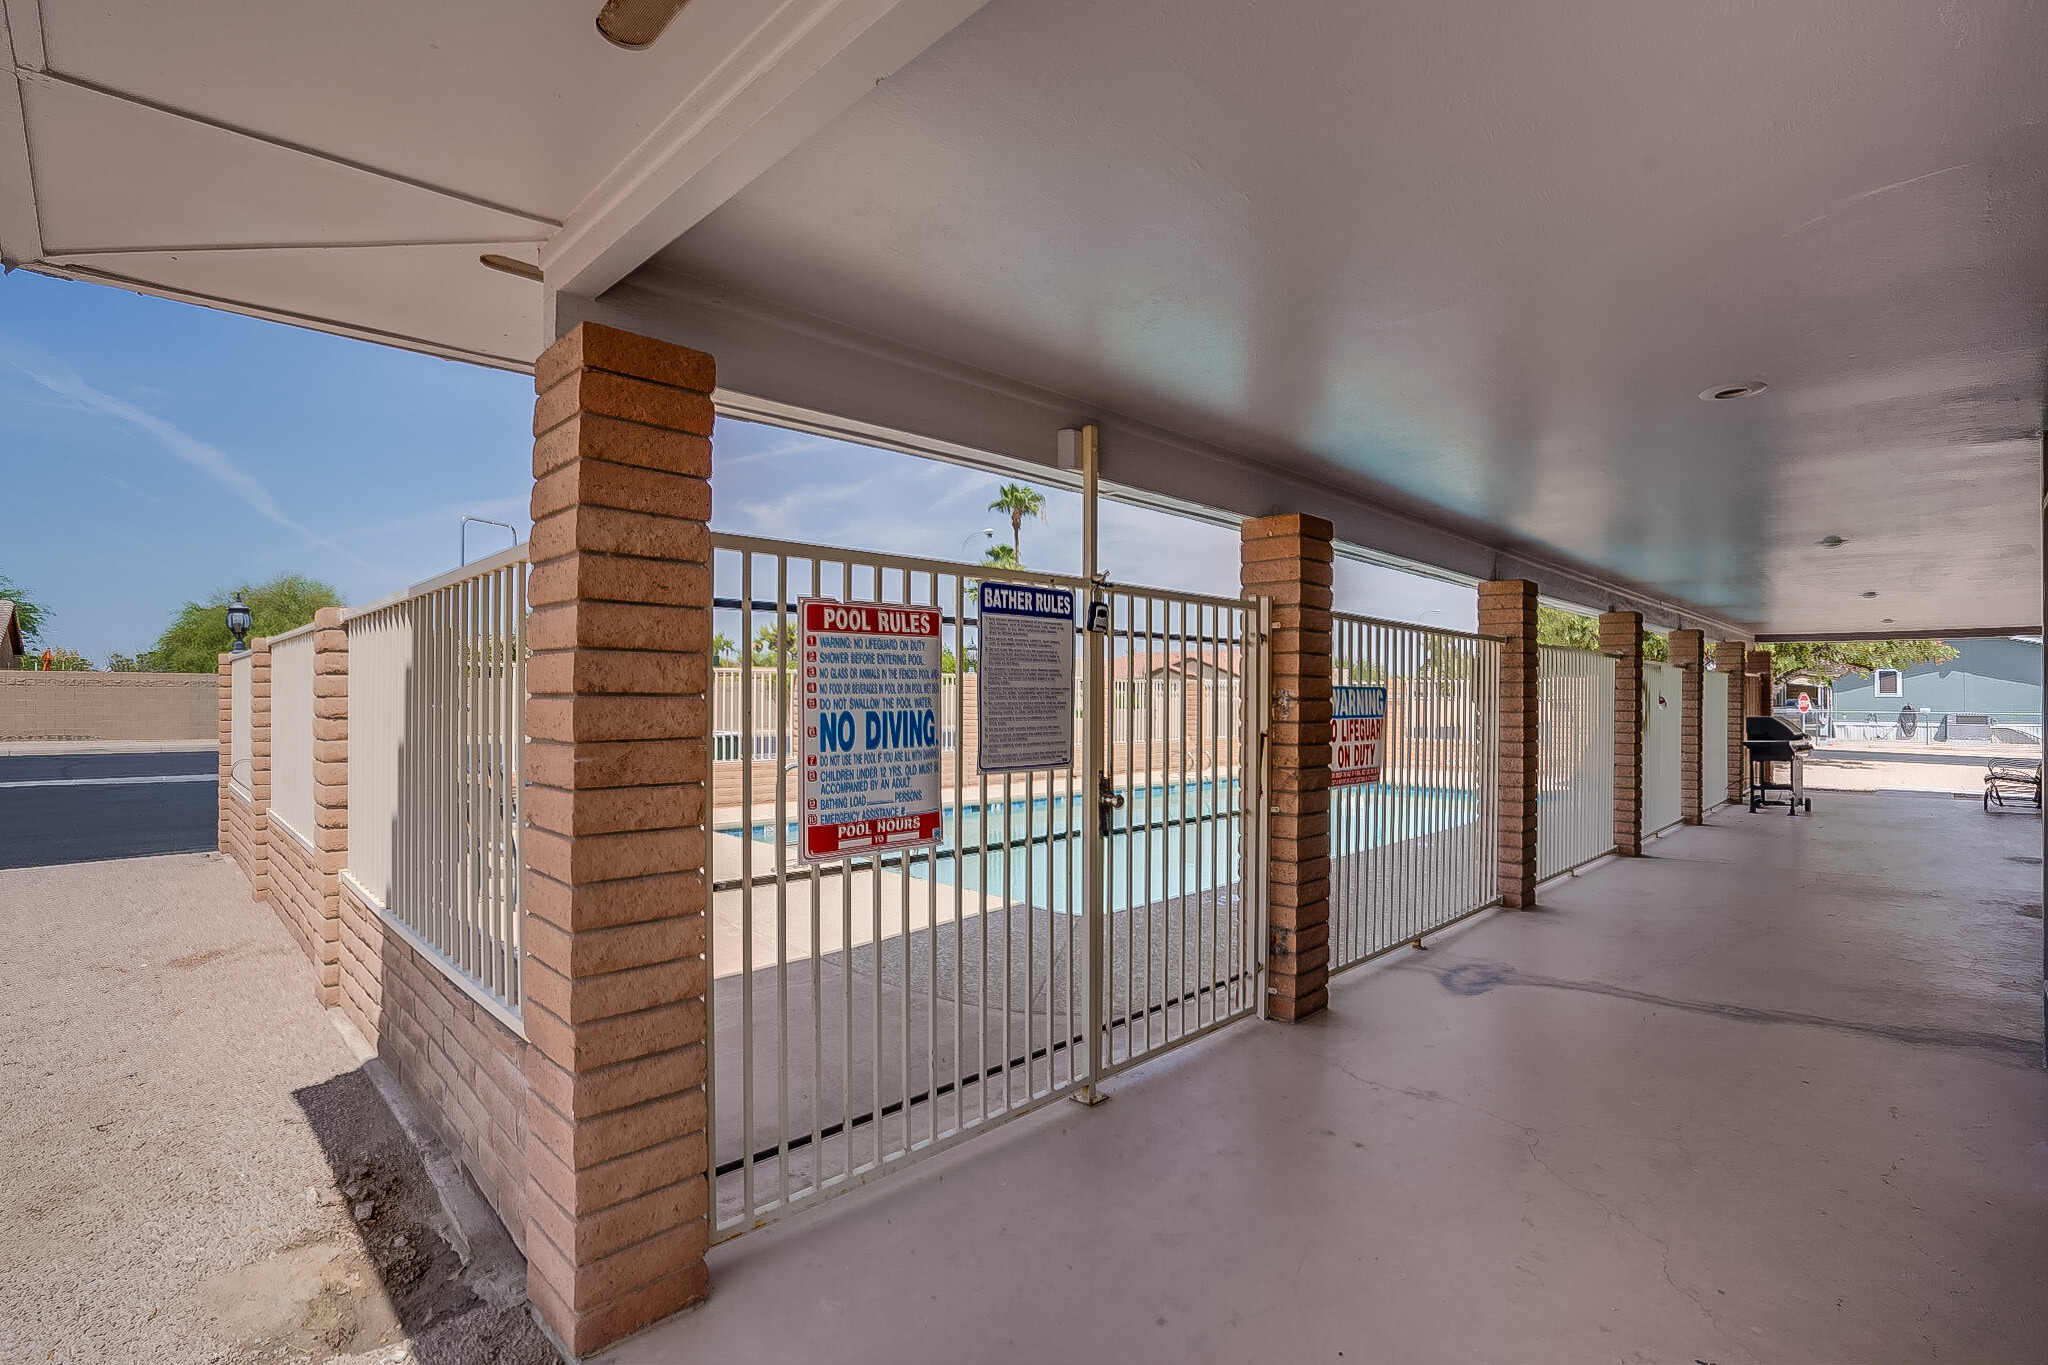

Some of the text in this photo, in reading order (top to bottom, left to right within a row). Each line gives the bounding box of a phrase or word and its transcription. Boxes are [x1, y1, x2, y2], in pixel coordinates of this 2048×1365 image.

[984, 587, 1071, 614] BATHER RULES
[823, 607, 931, 634] POOL RULES
[854, 637, 864, 649] NO
[865, 638, 898, 650] LIFEGUARD
[901, 640, 909, 651] ON
[820, 651, 849, 664] SHOWER
[850, 653, 875, 665] BEFORE
[877, 654, 906, 666] ENTERING
[820, 667, 829, 679] NO
[830, 667, 848, 679] GLASS
[850, 668, 858, 679] OR
[859, 668, 880, 679] ANIMALS
[881, 668, 887, 679] IN
[888, 668, 898, 679] THE
[899, 668, 917, 679] FENCED
[919, 669, 930, 679] POOL
[820, 683, 828, 694] NO
[829, 683, 842, 694] FOOD
[844, 683, 851, 694] OR
[852, 683, 878, 694] BEVERAGES
[879, 683, 884, 694] IN
[885, 683, 896, 694] POOL
[898, 683, 904, 694] OR
[912, 683, 923, 694] POOL
[820, 698, 831, 710] DO
[833, 697, 848, 709] NOT
[849, 697, 880, 709] SWALLOW
[882, 697, 894, 709] THE
[896, 697, 912, 709] POOL
[820, 710, 855, 752] NO
[1331, 719, 1338, 742] O
[820, 755, 829, 767] DO
[830, 755, 840, 766] NOT
[842, 754, 852, 766] USE
[853, 753, 863, 765] THE
[864, 753, 876, 765] POOL
[878, 753, 883, 763] IF
[883, 752, 894, 764] YOU
[895, 751, 904, 762] ARE
[1338, 743, 1375, 768] ON DUTY
[820, 769, 855, 782] CHILDREN
[856, 767, 878, 780] UNDER
[880, 766, 887, 778] 12
[905, 764, 918, 776] OLD
[919, 762, 933, 774] MUST
[820, 779, 868, 795] ACCOMPANIED
[870, 779, 879, 791] BY
[880, 778, 890, 790] AN
[820, 797, 848, 810] BATHING
[820, 810, 861, 825] EMERGENCY
[862, 806, 899, 821] ASSISTANCE
[838, 816, 921, 838] POOL HOURS
[874, 835, 885, 844] TO
